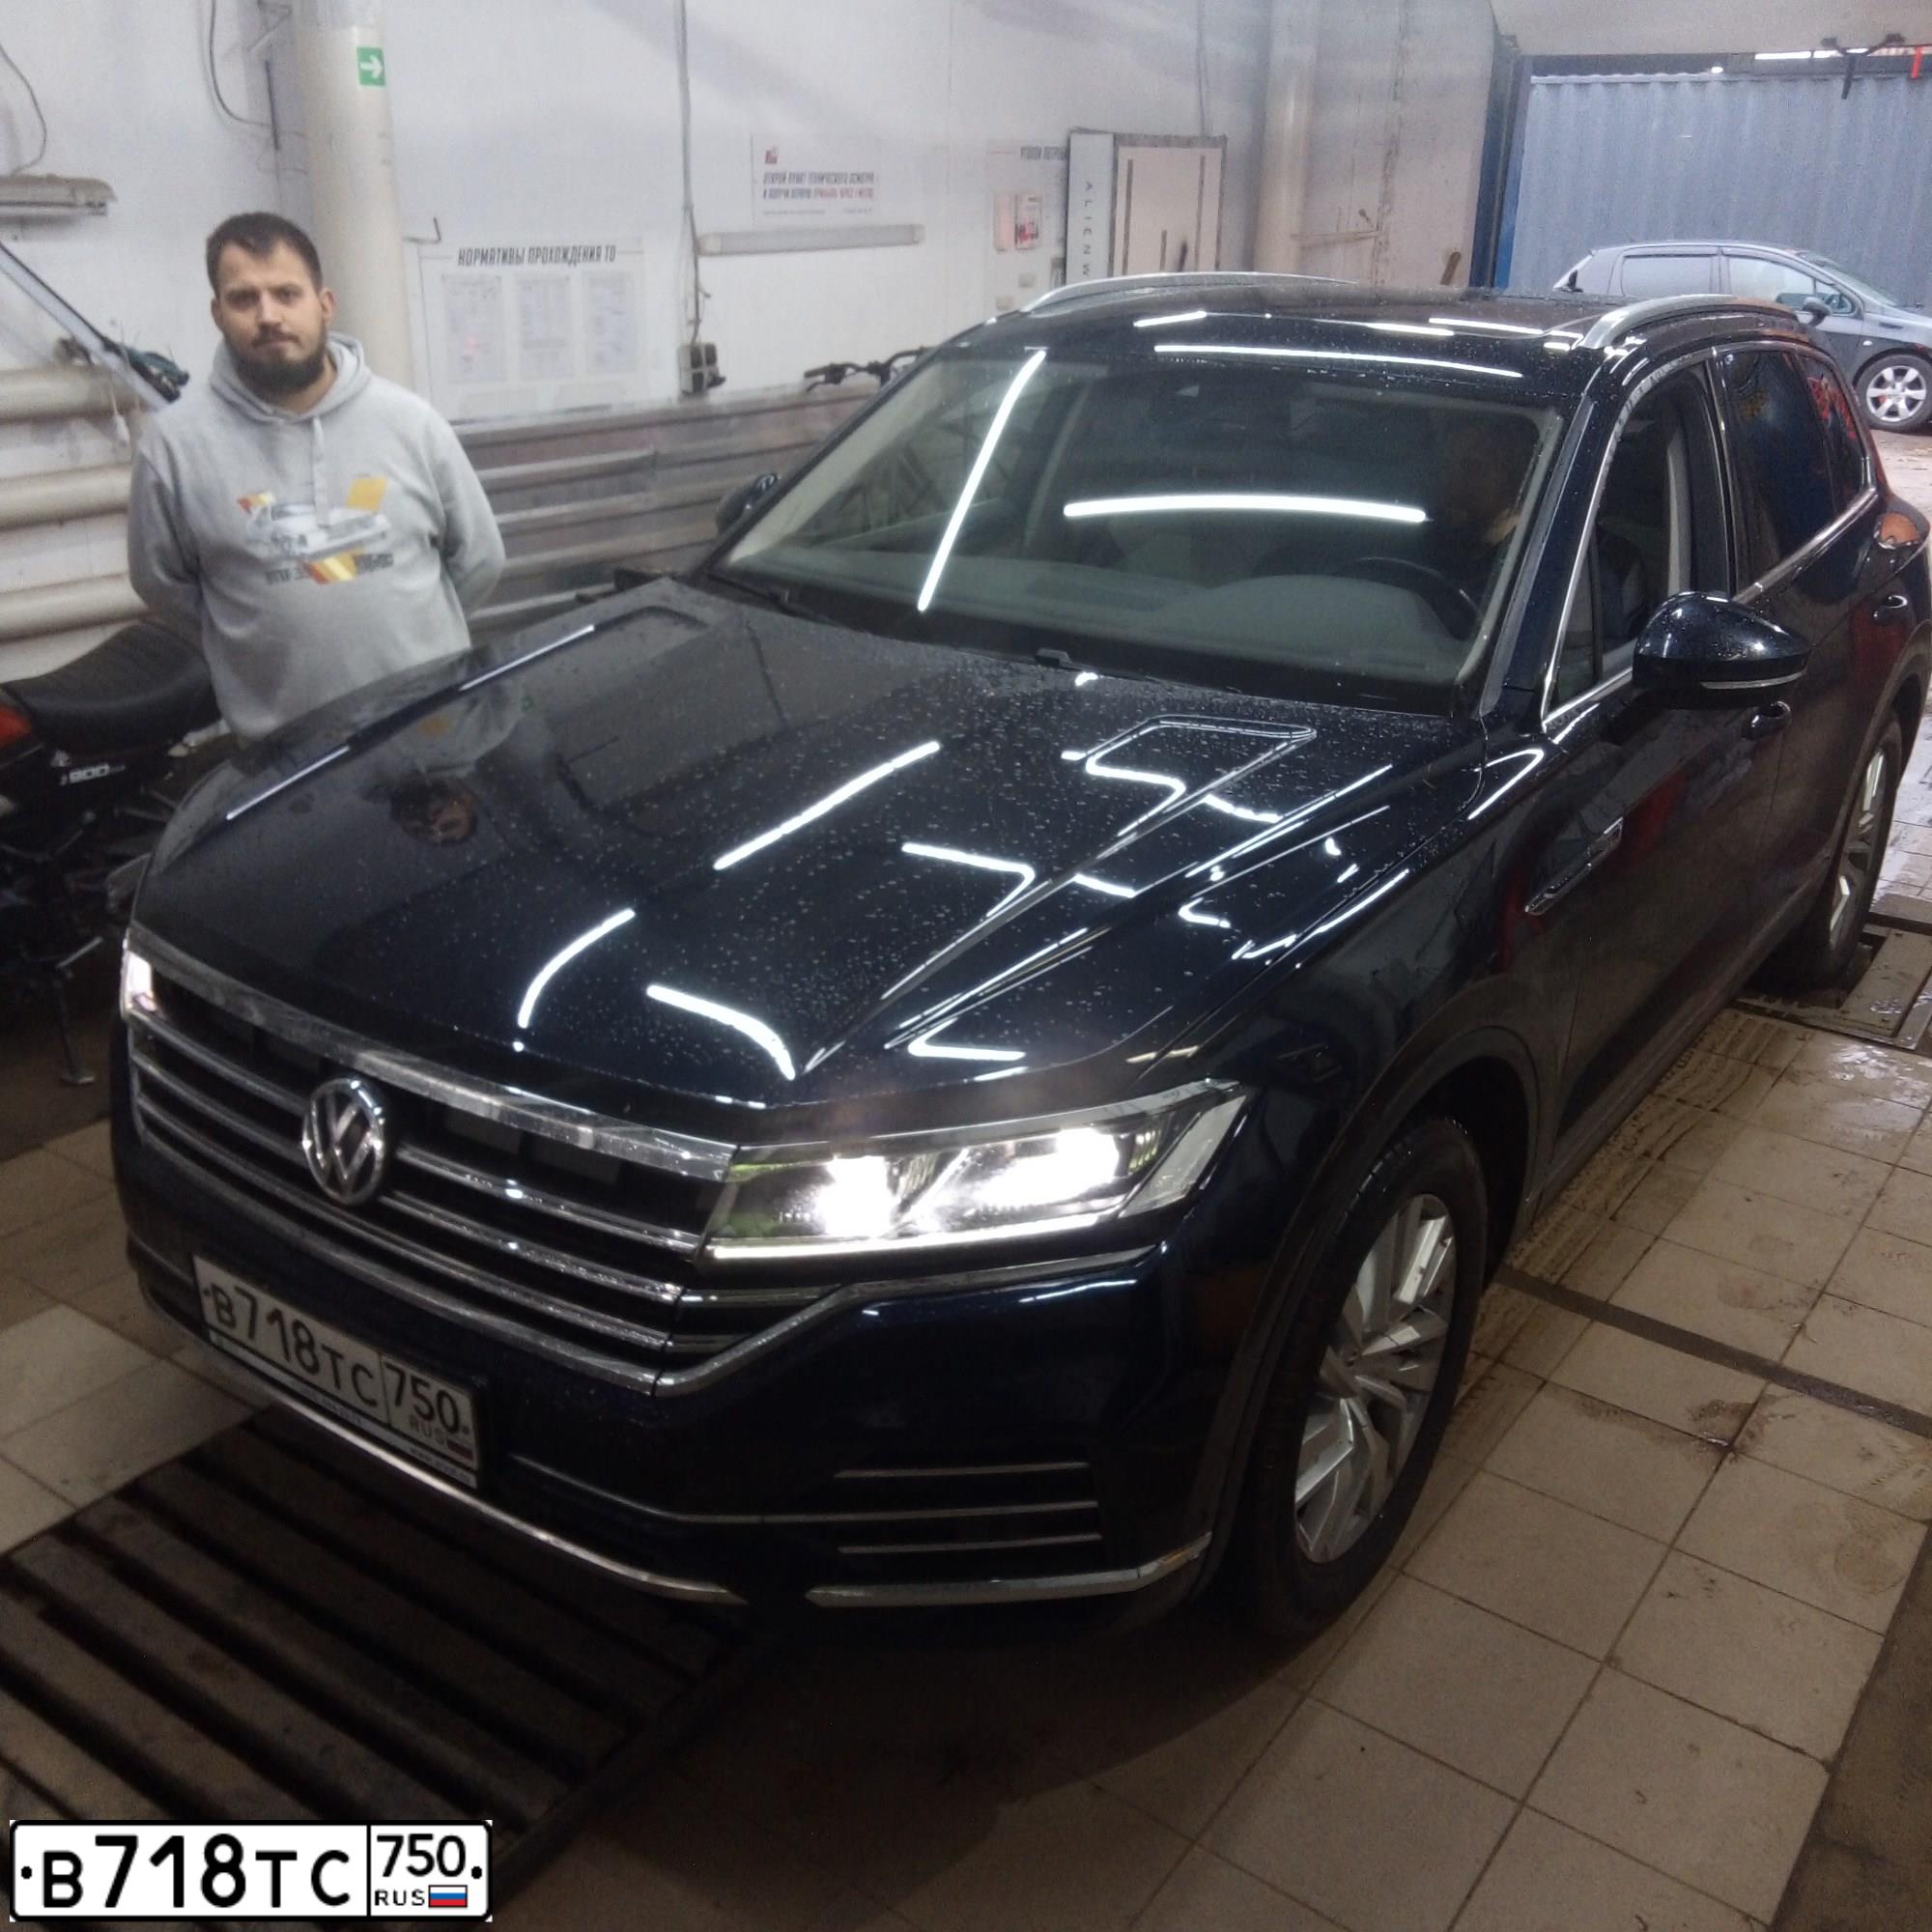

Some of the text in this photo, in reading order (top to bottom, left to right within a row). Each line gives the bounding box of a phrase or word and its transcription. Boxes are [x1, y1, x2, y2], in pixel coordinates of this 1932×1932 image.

[458, 244, 617, 267] НОРМАТИВЫ ПРОХОЖДЕНИЯ ТО
[384, 1358, 459, 1434] 750
[408, 1413, 448, 1449] RUS
